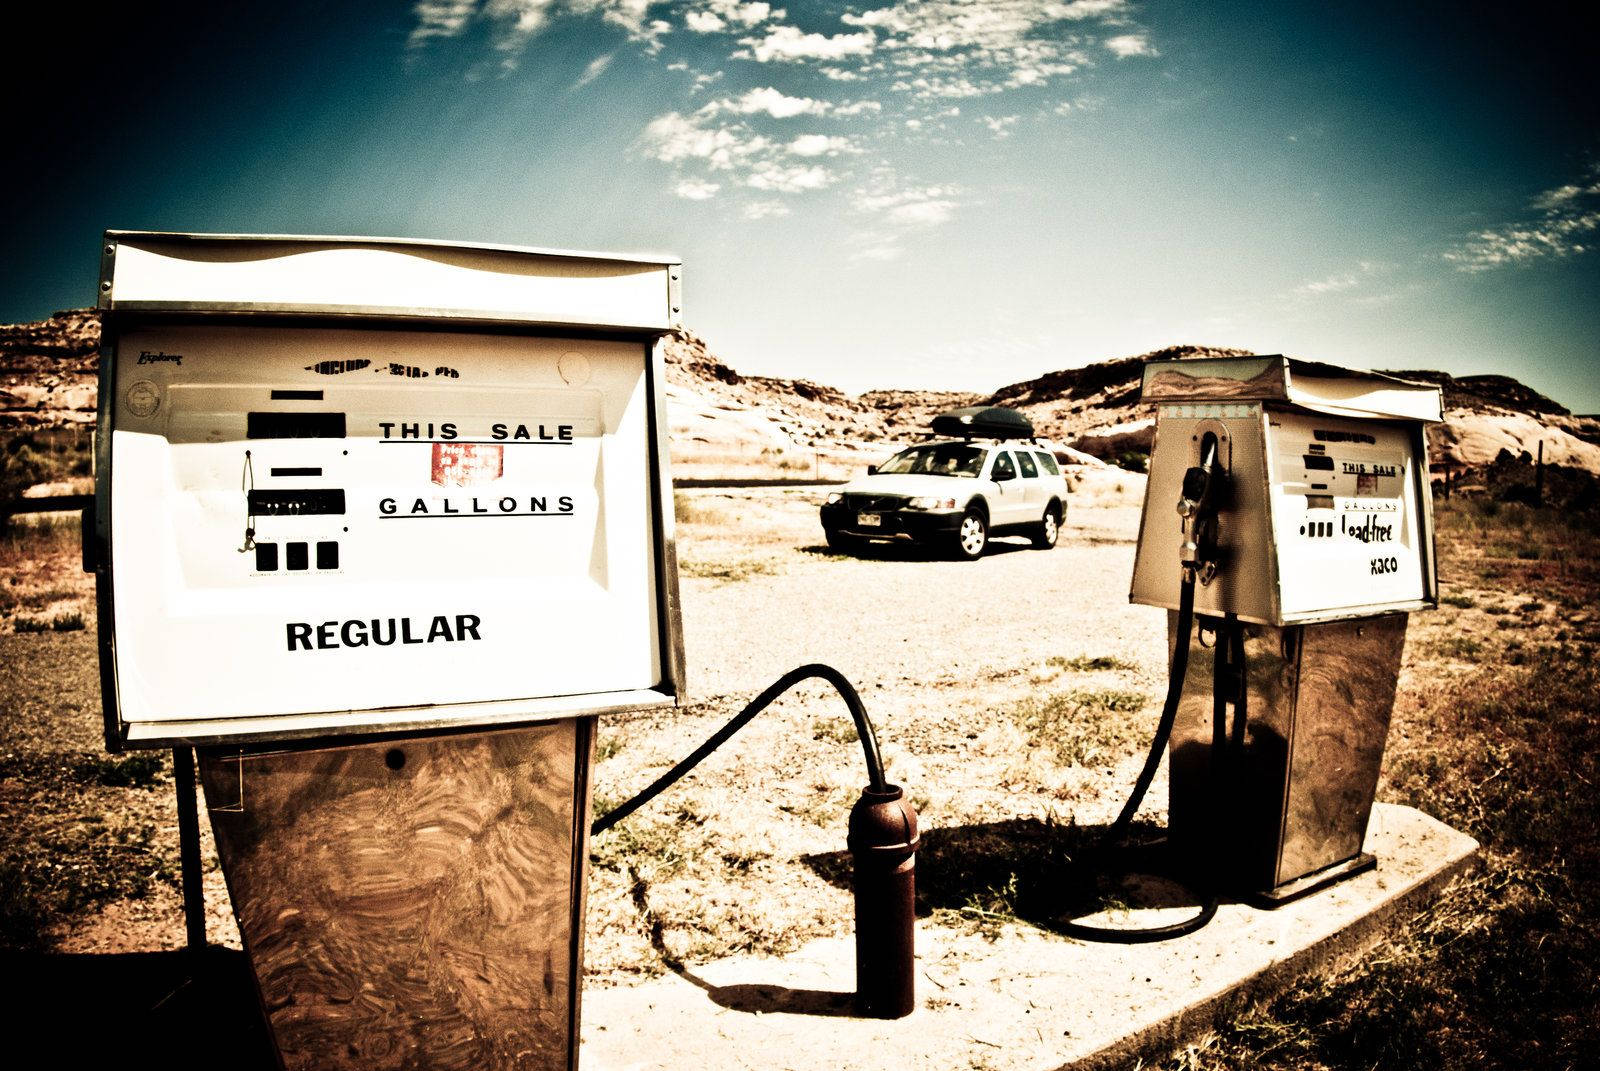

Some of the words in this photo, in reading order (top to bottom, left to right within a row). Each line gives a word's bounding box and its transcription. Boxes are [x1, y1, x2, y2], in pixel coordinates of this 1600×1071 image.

[379, 422, 458, 440] THIS
[491, 424, 573, 441] SALE
[1342, 462, 1365, 474] THIS
[1373, 464, 1396, 475] SALE
[379, 497, 574, 514] GALLONS
[286, 614, 482, 651] REGULAR
